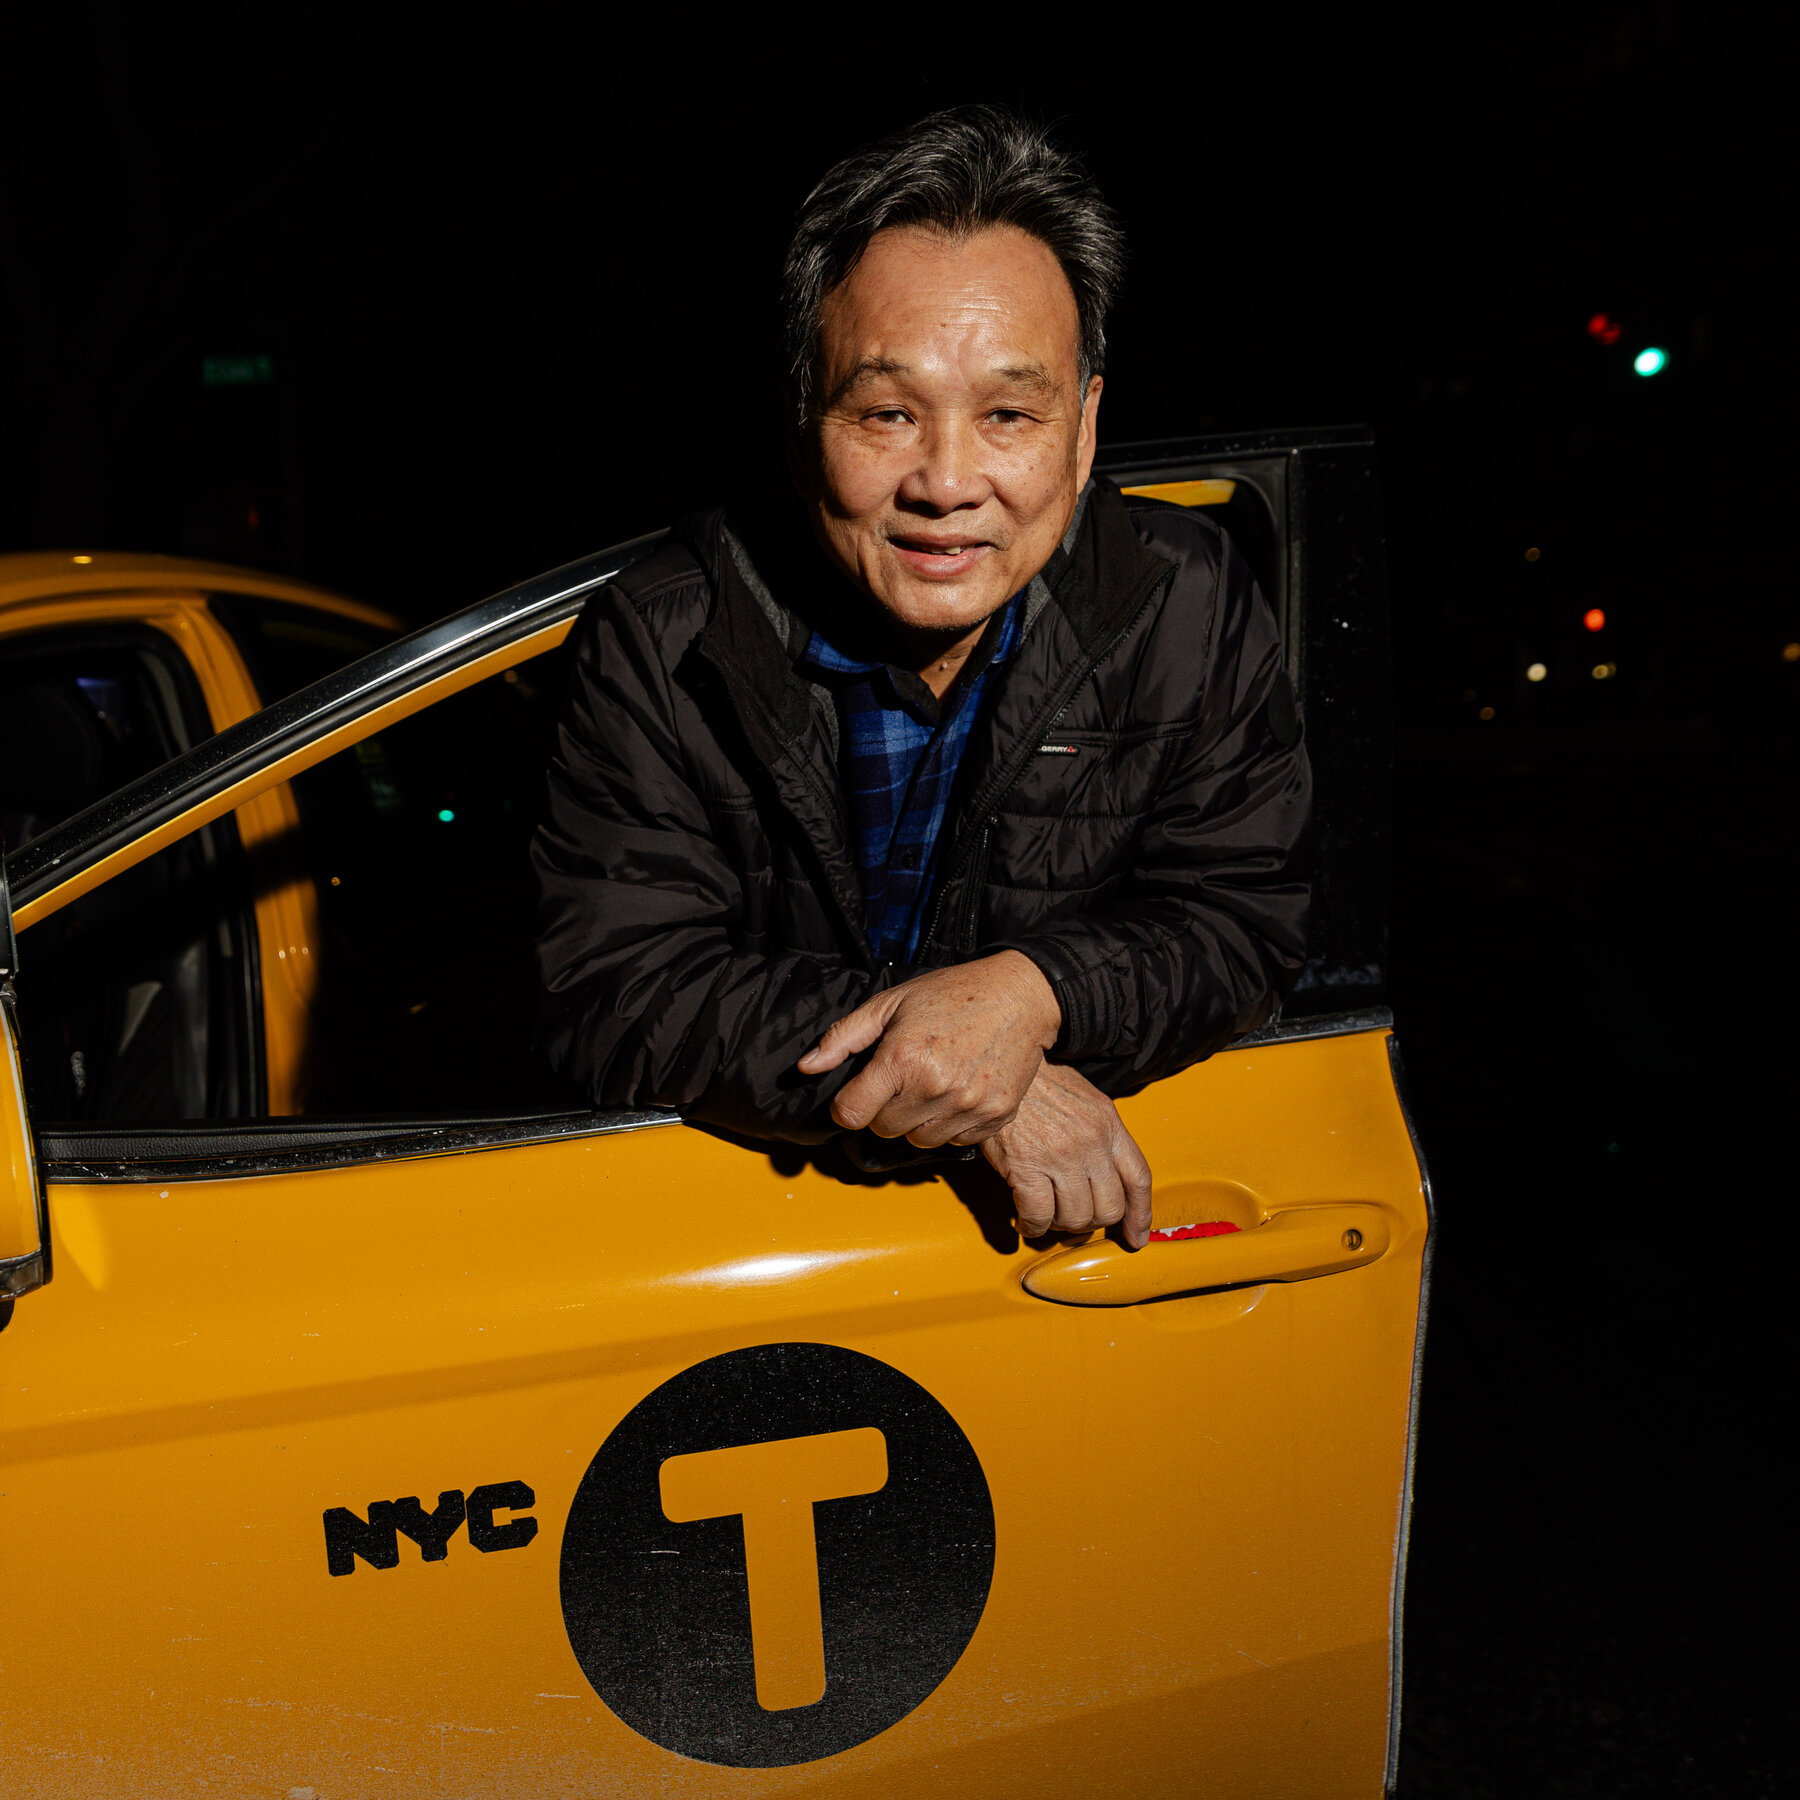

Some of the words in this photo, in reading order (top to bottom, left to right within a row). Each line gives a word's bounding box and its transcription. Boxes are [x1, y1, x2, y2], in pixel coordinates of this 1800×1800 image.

[1041, 745, 1068, 753] GERRY
[323, 1480, 538, 1577] NYC
[659, 1427, 888, 1711] T
